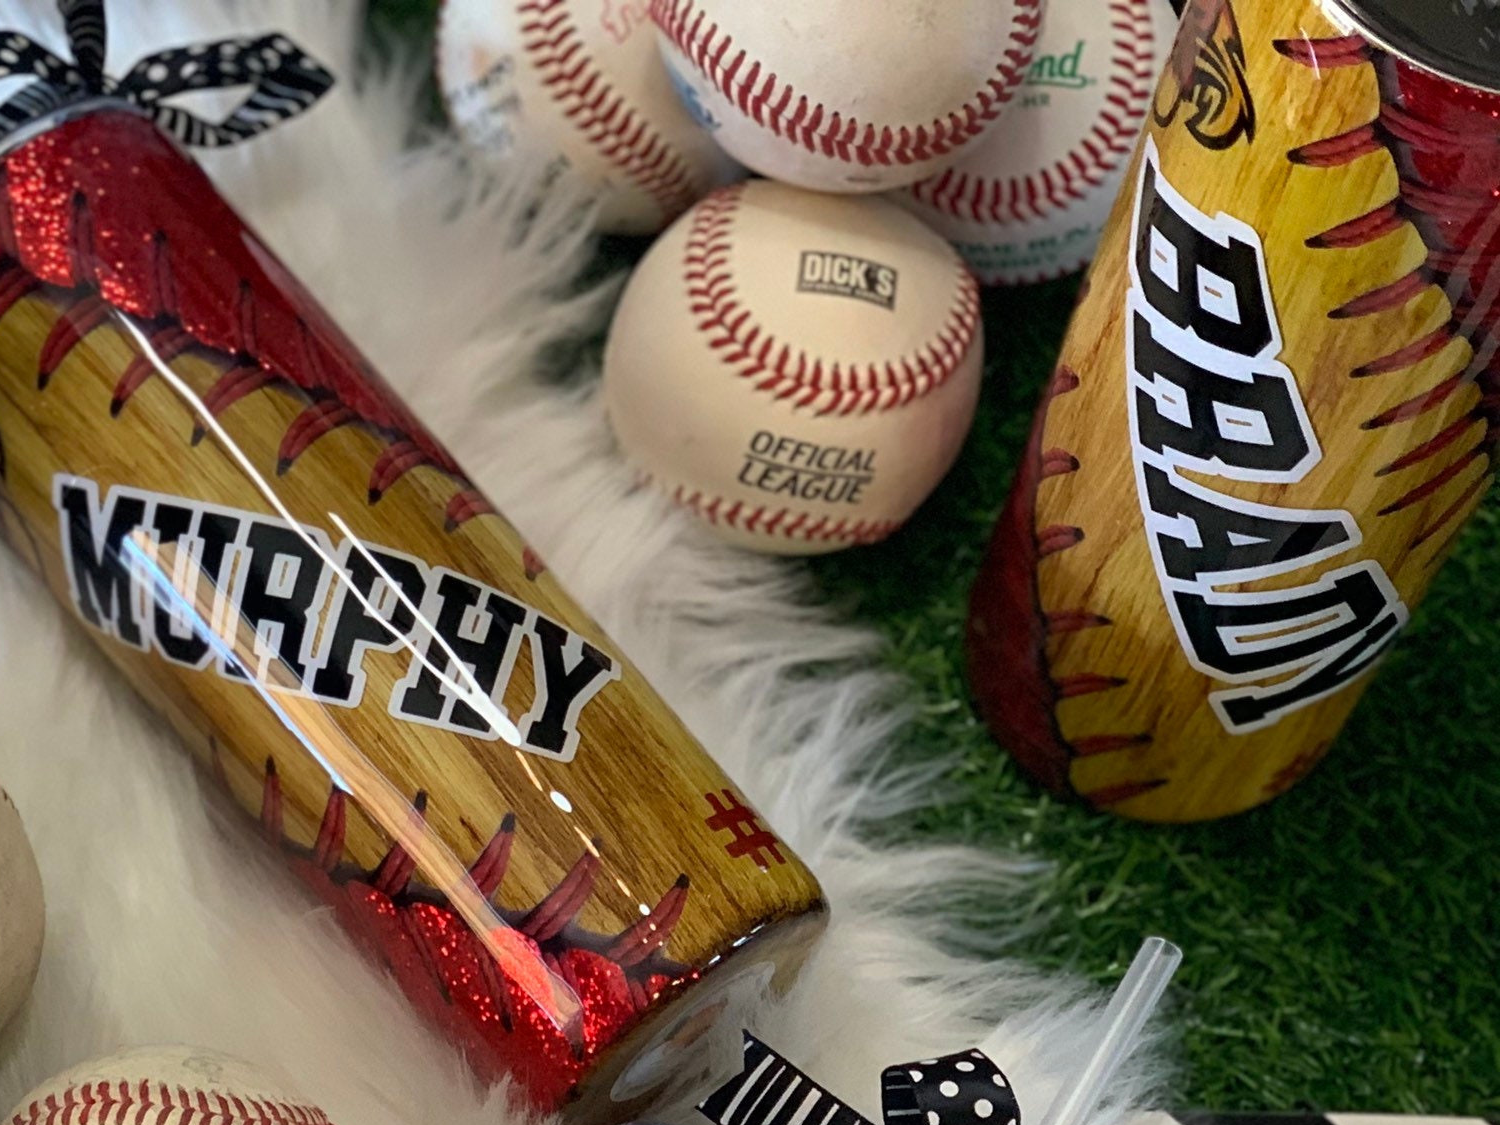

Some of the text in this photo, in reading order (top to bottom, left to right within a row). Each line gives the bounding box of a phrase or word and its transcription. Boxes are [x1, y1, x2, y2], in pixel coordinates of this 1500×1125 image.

[737, 459, 871, 504] LEAGUE
[749, 430, 876, 472] OFFICIAL
[1126, 136, 1409, 735] BRADY
[53, 472, 621, 761] MURPHY
